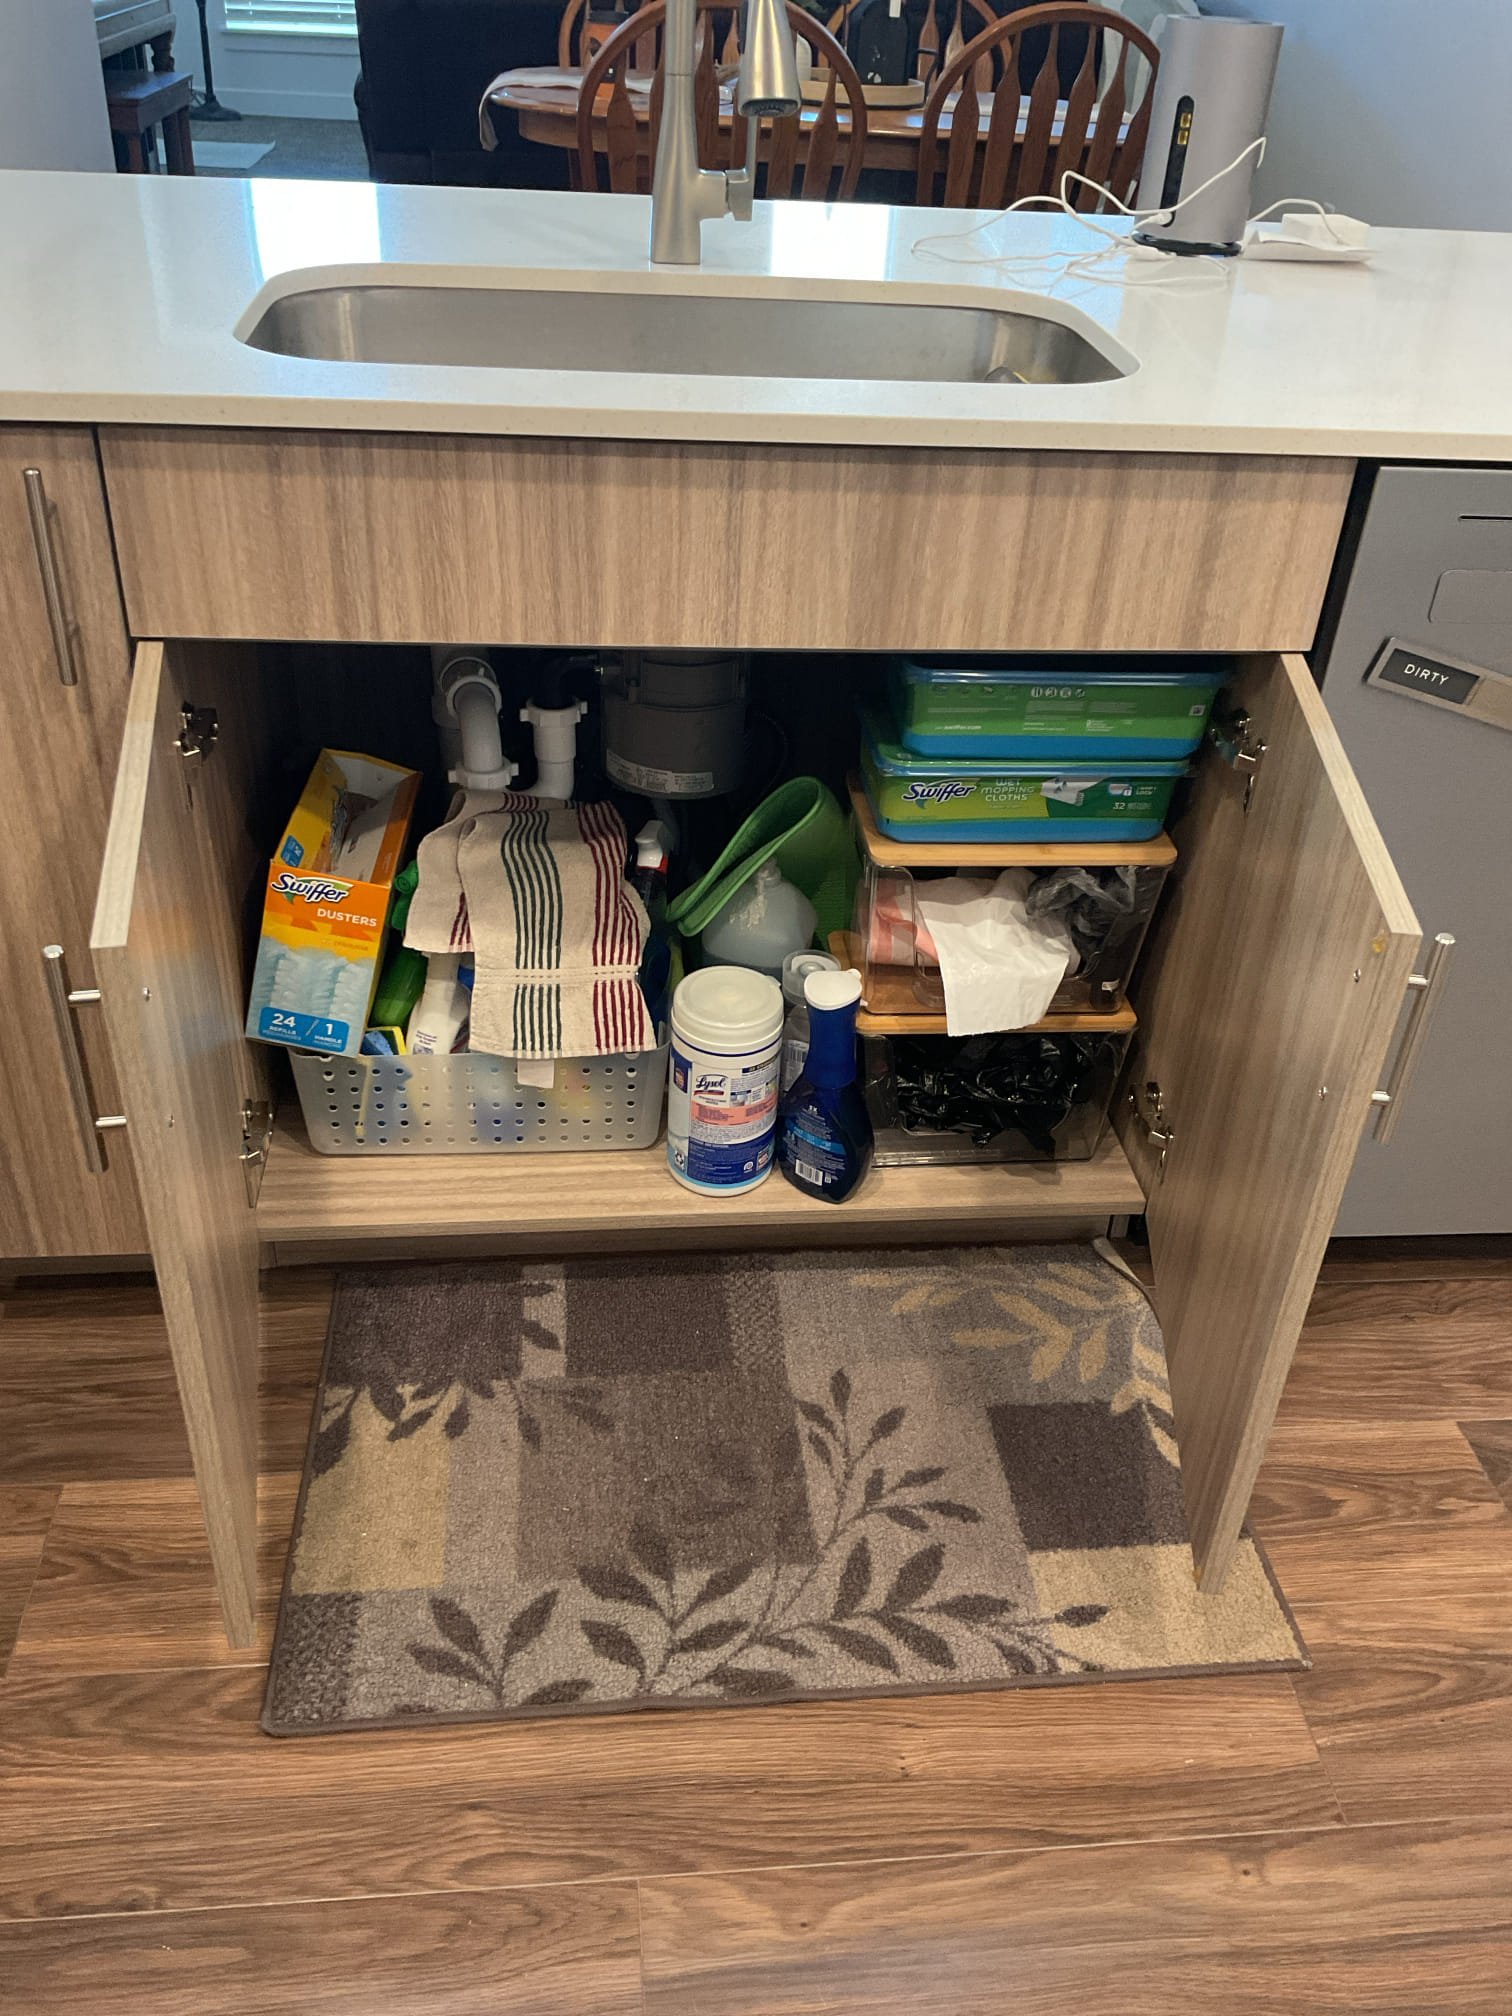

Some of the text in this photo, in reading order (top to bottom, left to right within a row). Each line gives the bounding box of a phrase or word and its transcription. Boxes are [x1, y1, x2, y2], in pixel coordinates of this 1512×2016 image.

[1404, 663, 1449, 685] DIRTY
[996, 778, 1022, 786] WET
[902, 782, 976, 803] Swiffer
[982, 786, 1034, 794] MOPPING
[985, 794, 1027, 802] CLOTHS
[271, 873, 348, 903] Swiffer
[317, 908, 377, 927] DUSTERS
[272, 1013, 296, 1028] 24
[325, 1023, 333, 1035] 1
[696, 1076, 726, 1091] Lysol
